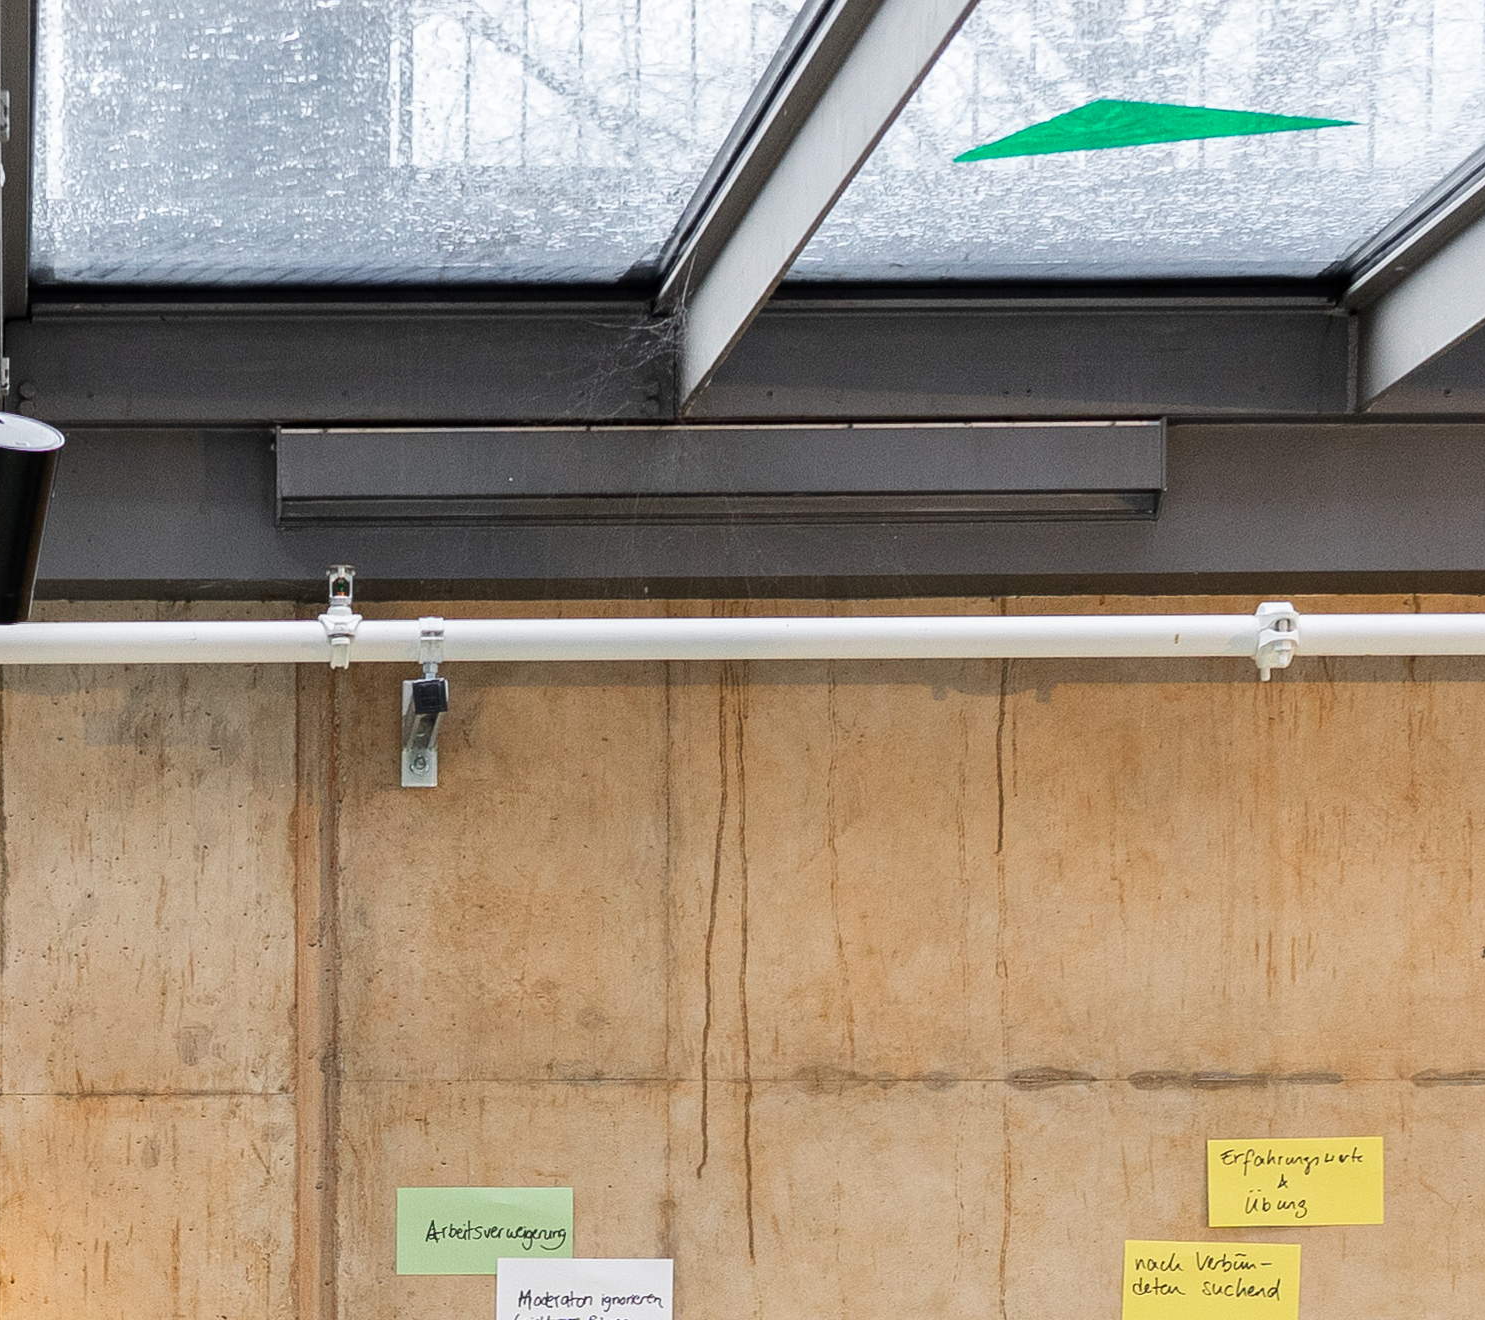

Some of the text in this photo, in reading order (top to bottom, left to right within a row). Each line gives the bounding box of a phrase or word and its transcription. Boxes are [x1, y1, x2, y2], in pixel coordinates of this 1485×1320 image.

[1219, 1146, 1363, 1178] Erfahrungswerte
[1244, 1189, 1308, 1219] Übung
[425, 1219, 567, 1251] Arbeitsverweigerung
[1135, 1252, 1184, 1272] nach
[518, 1289, 664, 1313] Moderation ignorieren
[1132, 1276, 1281, 1301] deten suchend
